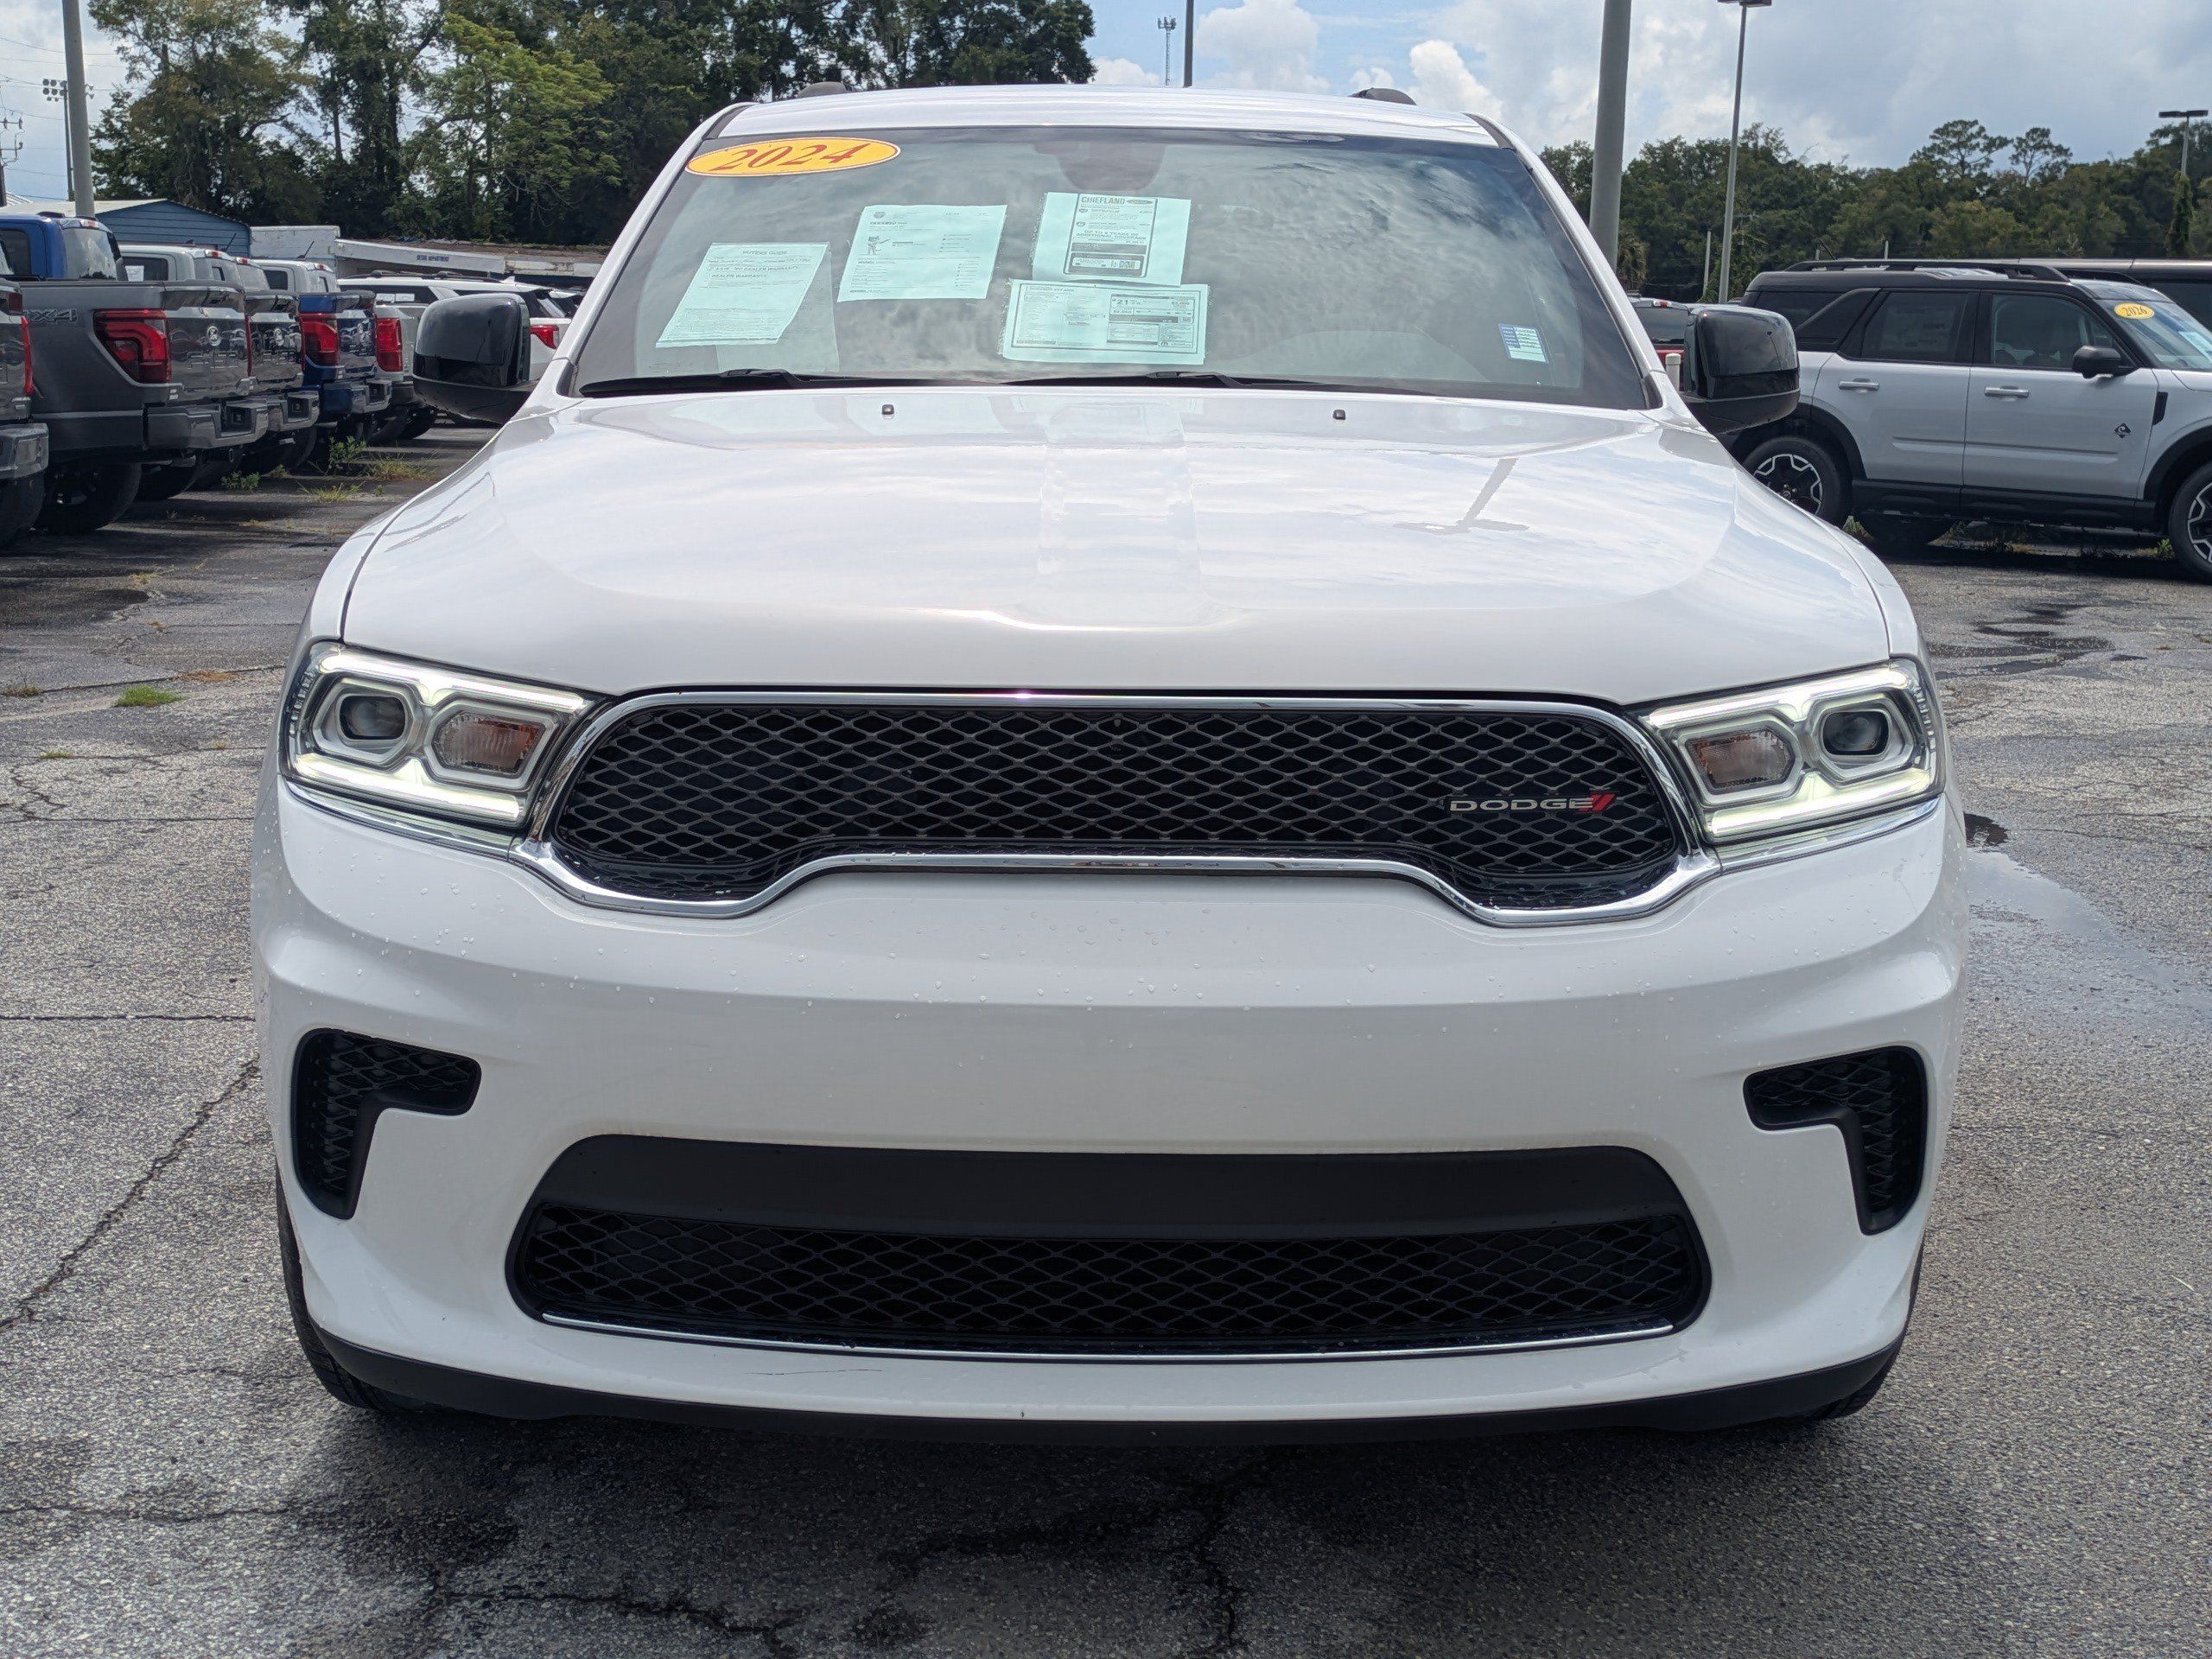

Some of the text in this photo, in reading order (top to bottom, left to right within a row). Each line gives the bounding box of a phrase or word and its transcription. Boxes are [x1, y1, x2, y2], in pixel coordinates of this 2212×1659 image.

[708, 143, 871, 172] 2024
[1081, 196, 1126, 205] CHIEFLAND
[1449, 798, 1594, 811] DODGE
